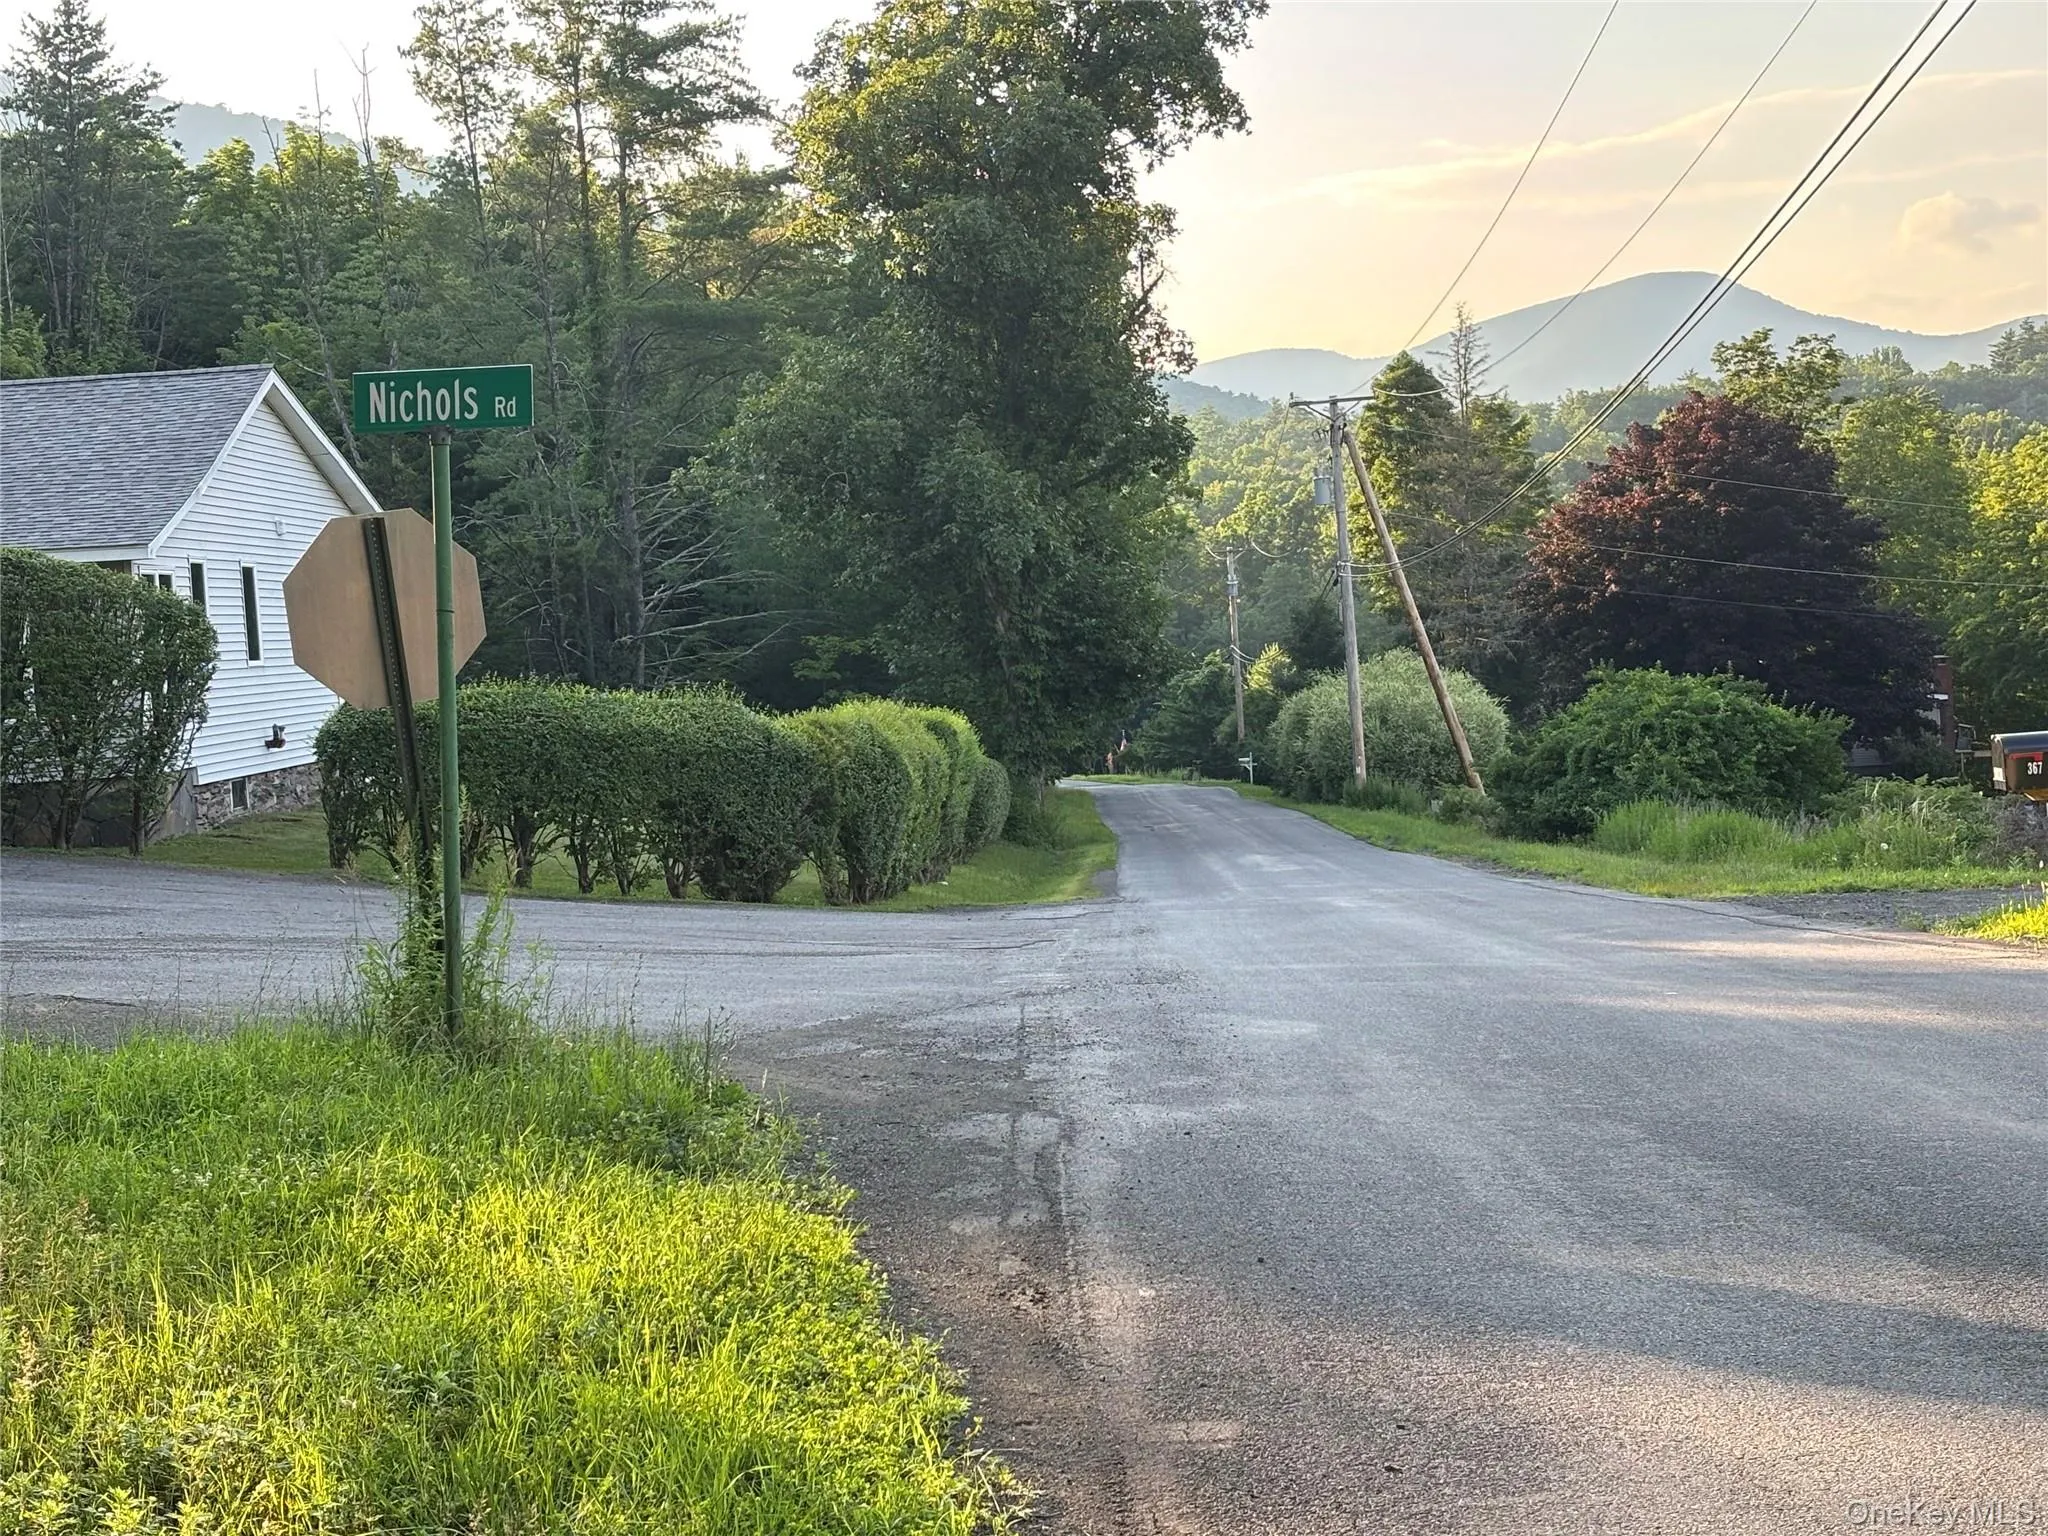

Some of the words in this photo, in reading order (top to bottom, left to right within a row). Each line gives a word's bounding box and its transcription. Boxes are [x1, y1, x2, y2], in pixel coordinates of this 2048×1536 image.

[369, 378, 479, 424] Nichols
[494, 396, 517, 418] Rd
[2027, 761, 2043, 775] 367
